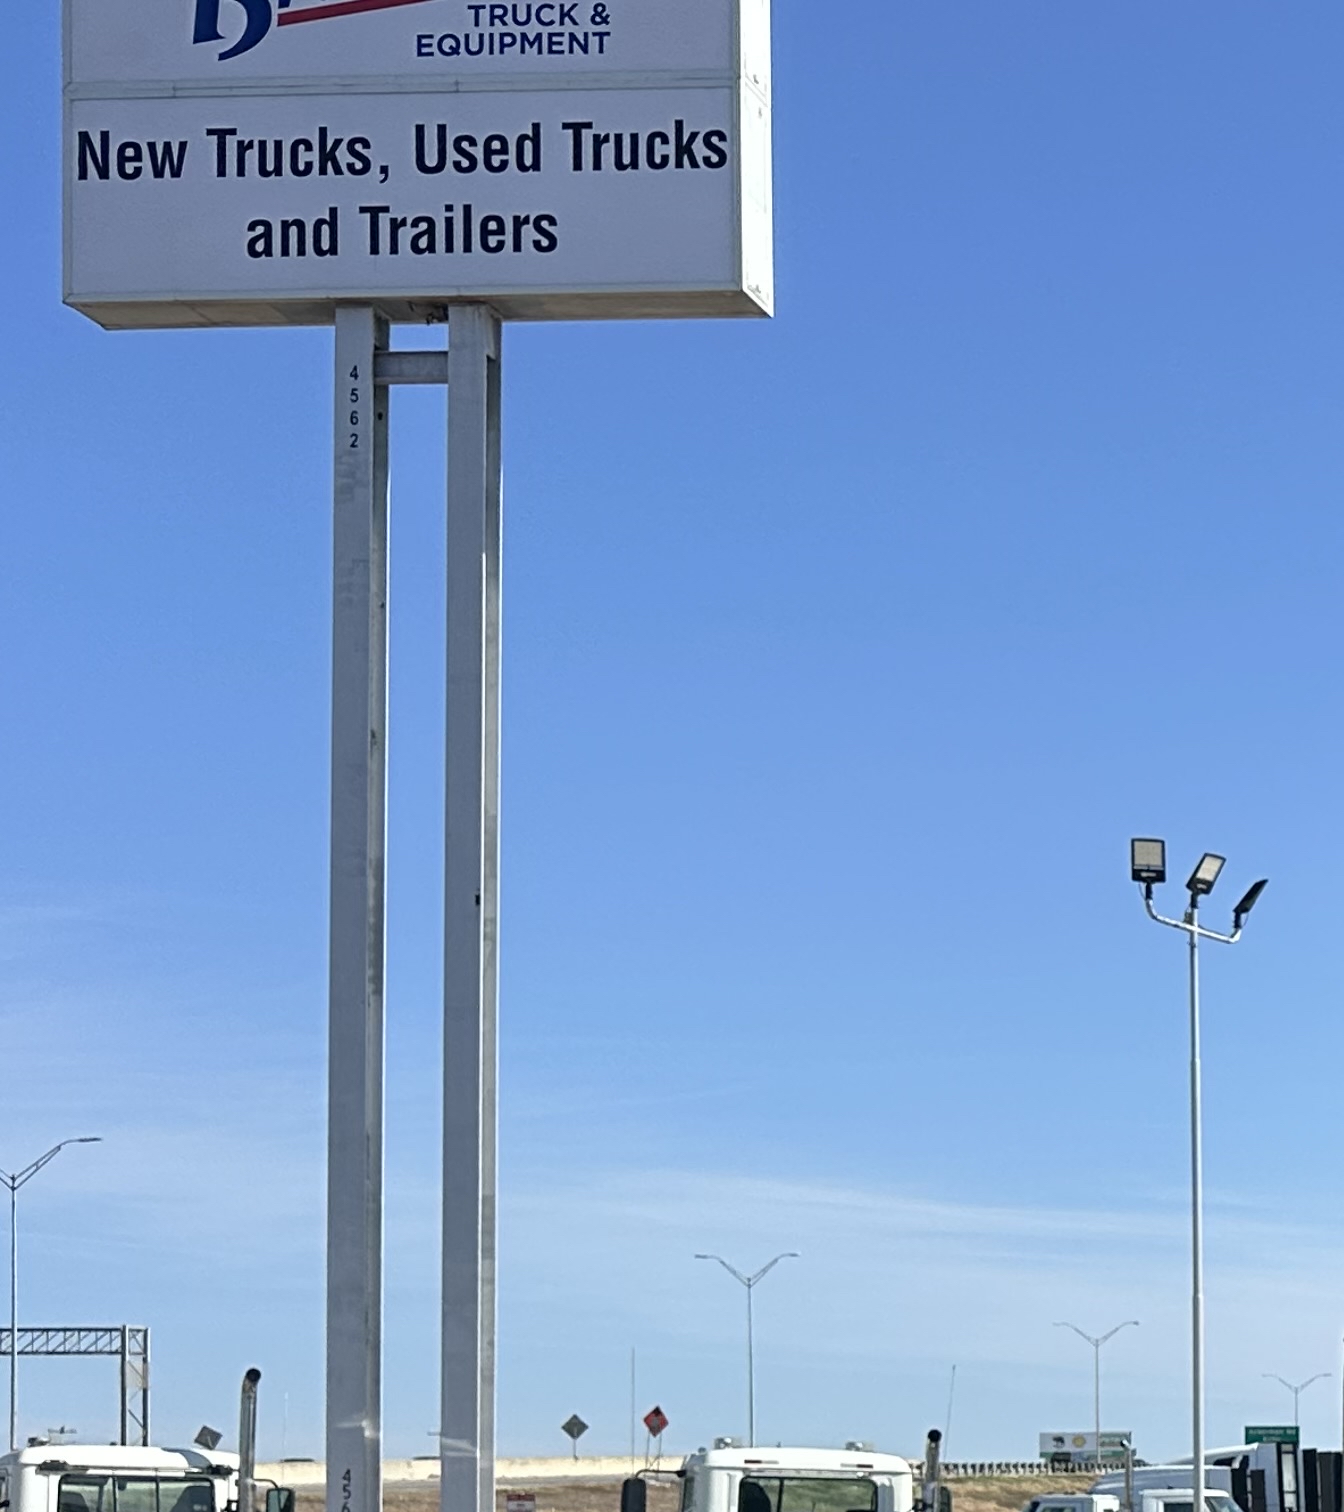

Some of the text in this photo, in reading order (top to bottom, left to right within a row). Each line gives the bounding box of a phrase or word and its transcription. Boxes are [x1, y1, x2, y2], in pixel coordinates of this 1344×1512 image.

[467, 2, 611, 28] TRUCK &
[416, 31, 611, 58] EQUIPMENT
[77, 119, 728, 183] New Trucks, Used Trucks
[246, 204, 559, 258] and Trailers
